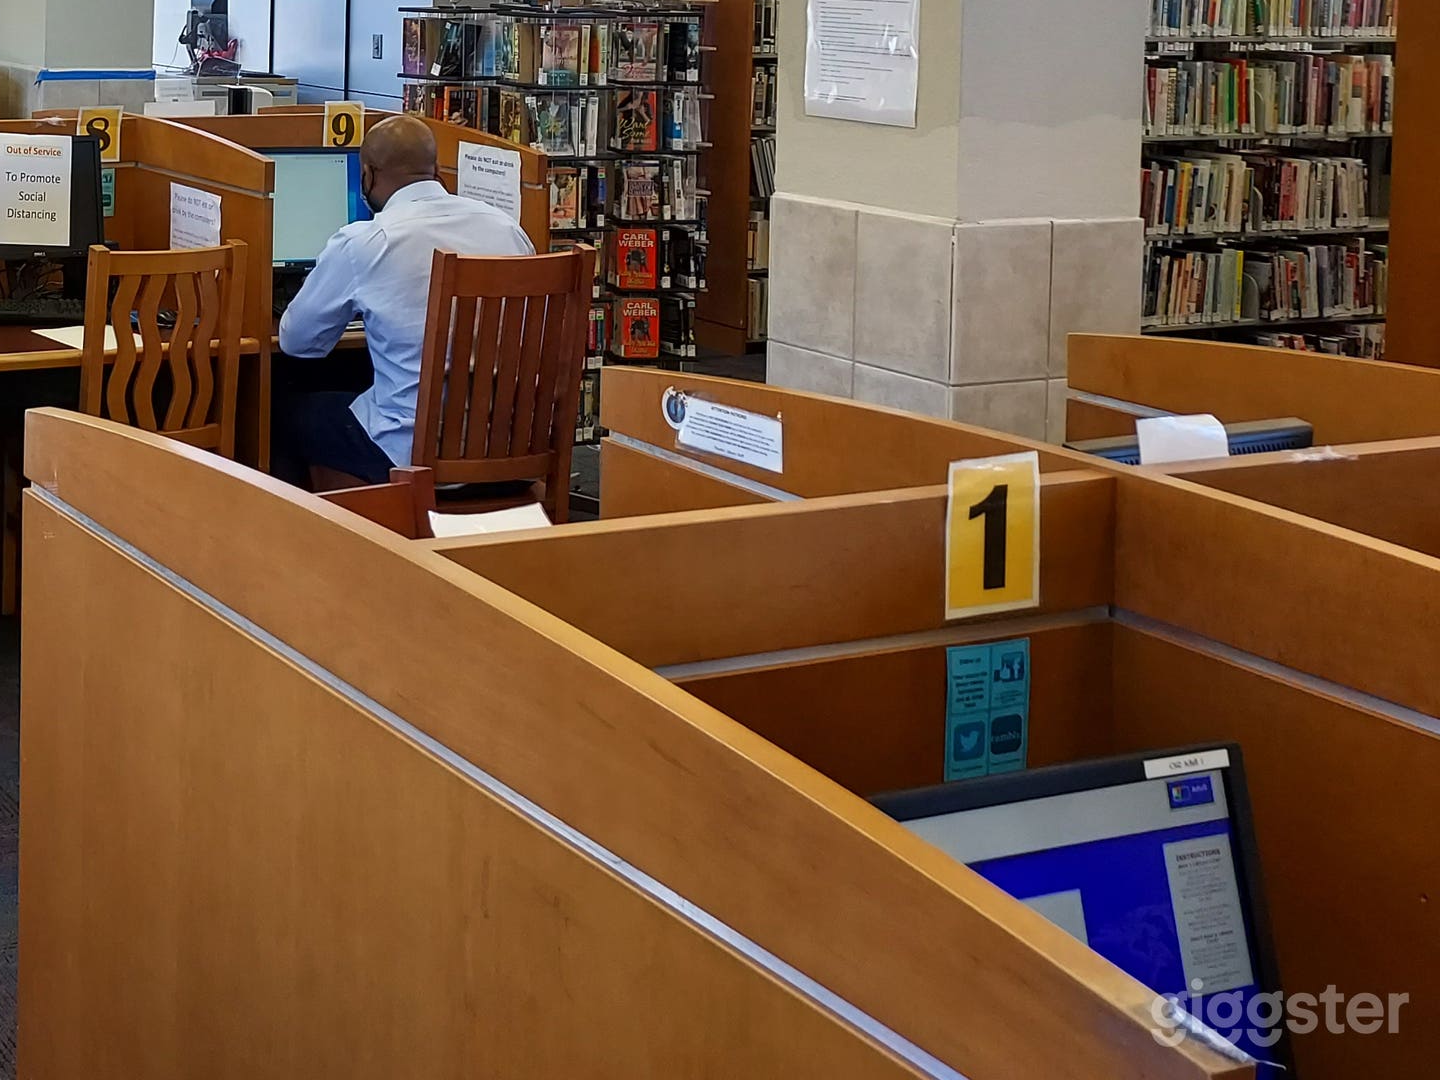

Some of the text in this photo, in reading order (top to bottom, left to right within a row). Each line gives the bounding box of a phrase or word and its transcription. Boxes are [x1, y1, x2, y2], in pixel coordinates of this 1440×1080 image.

[86, 117, 111, 152] 8
[332, 113, 355, 147] 9
[6, 146, 62, 156] Out of Service
[5, 172, 61, 184] To Promote
[18, 191, 46, 202] Social
[7, 208, 57, 222] Distancing
[622, 233, 650, 241] CARL
[618, 240, 654, 248] WEBER
[623, 309, 657, 317] WEBER
[969, 484, 1008, 590] 1
